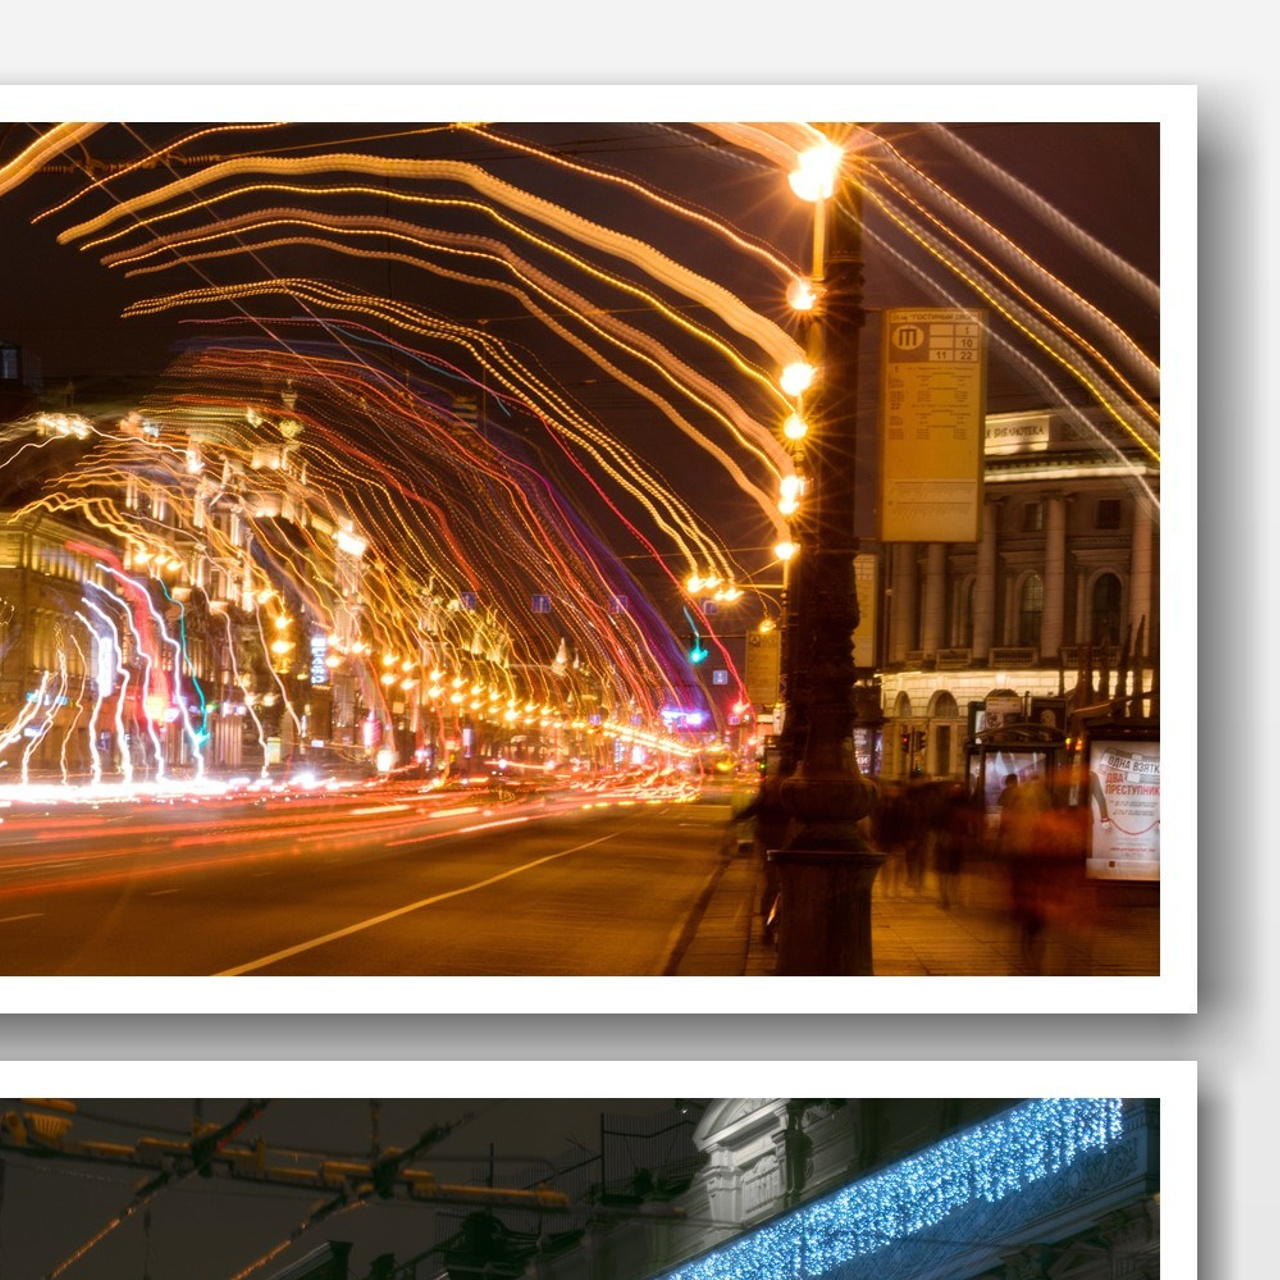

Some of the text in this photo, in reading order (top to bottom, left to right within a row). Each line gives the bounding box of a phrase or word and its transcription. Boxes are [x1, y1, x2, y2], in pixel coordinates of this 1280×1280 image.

[961, 339, 973, 347] 10
[936, 351, 973, 360] 11 22
[1108, 755, 1131, 770] ОДНА
[1105, 772, 1124, 784] ДВА
